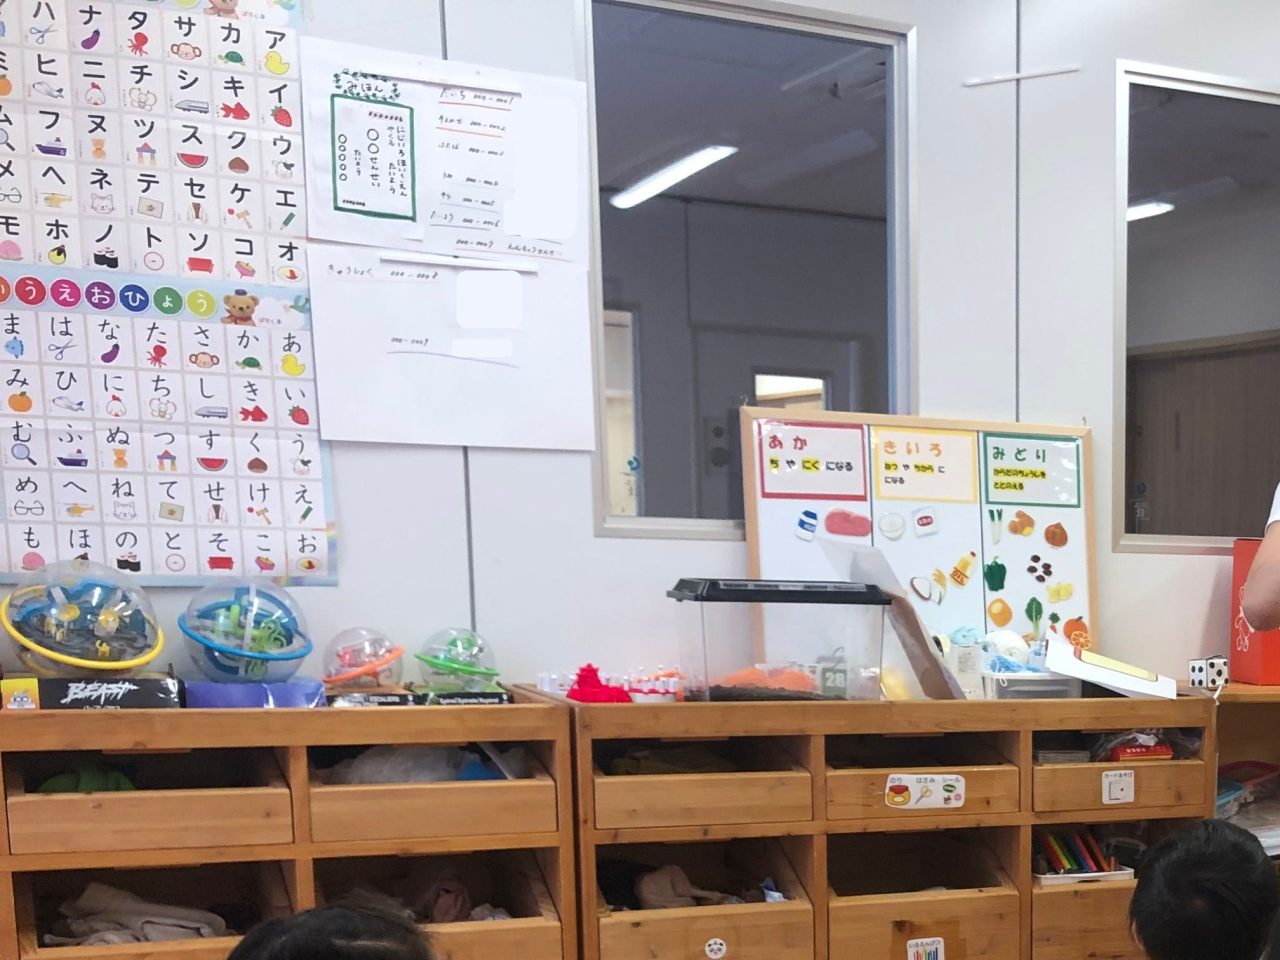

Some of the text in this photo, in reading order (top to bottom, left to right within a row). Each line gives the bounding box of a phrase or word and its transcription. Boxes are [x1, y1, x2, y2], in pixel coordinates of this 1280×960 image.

[33, 2, 285, 49] ハ ナ タ サ カ ア
[38, 54, 57, 75] ヒ
[83, 61, 105, 78] ニ
[131, 65, 152, 84] チ
[178, 70, 198, 89] シ
[224, 77, 244, 97] キ
[269, 84, 287, 103] イ
[39, 111, 59, 129] フ
[88, 115, 106, 133] ヌ
[134, 120, 154, 138] ツ
[182, 125, 202, 144] ス
[228, 132, 245, 149] ク
[273, 136, 291, 155] ウ
[42, 167, 65, 184] ヘ
[91, 169, 112, 189] ネ
[138, 174, 159, 193] テ
[185, 178, 205, 198] セ
[231, 183, 250, 203] ケ
[276, 190, 296, 207] エ
[46, 219, 68, 239] ホ
[96, 225, 112, 242] ノ
[147, 227, 161, 247] ト
[189, 233, 208, 251] ソ
[235, 239, 253, 255] コ
[279, 242, 298, 261] オ
[5, 313, 301, 352] ま は な た さ か あ
[7, 369, 305, 401] み ひ に ち し き い
[13, 421, 304, 453] む ふ ぬ つ す く う
[883, 440, 942, 457] きいろ
[802, 459, 820, 471] にく
[826, 461, 853, 472] になる
[992, 446, 1046, 463] みどり
[16, 477, 312, 503] め へ ね て せ け え
[24, 527, 316, 553] も ほ の と そ こ お
